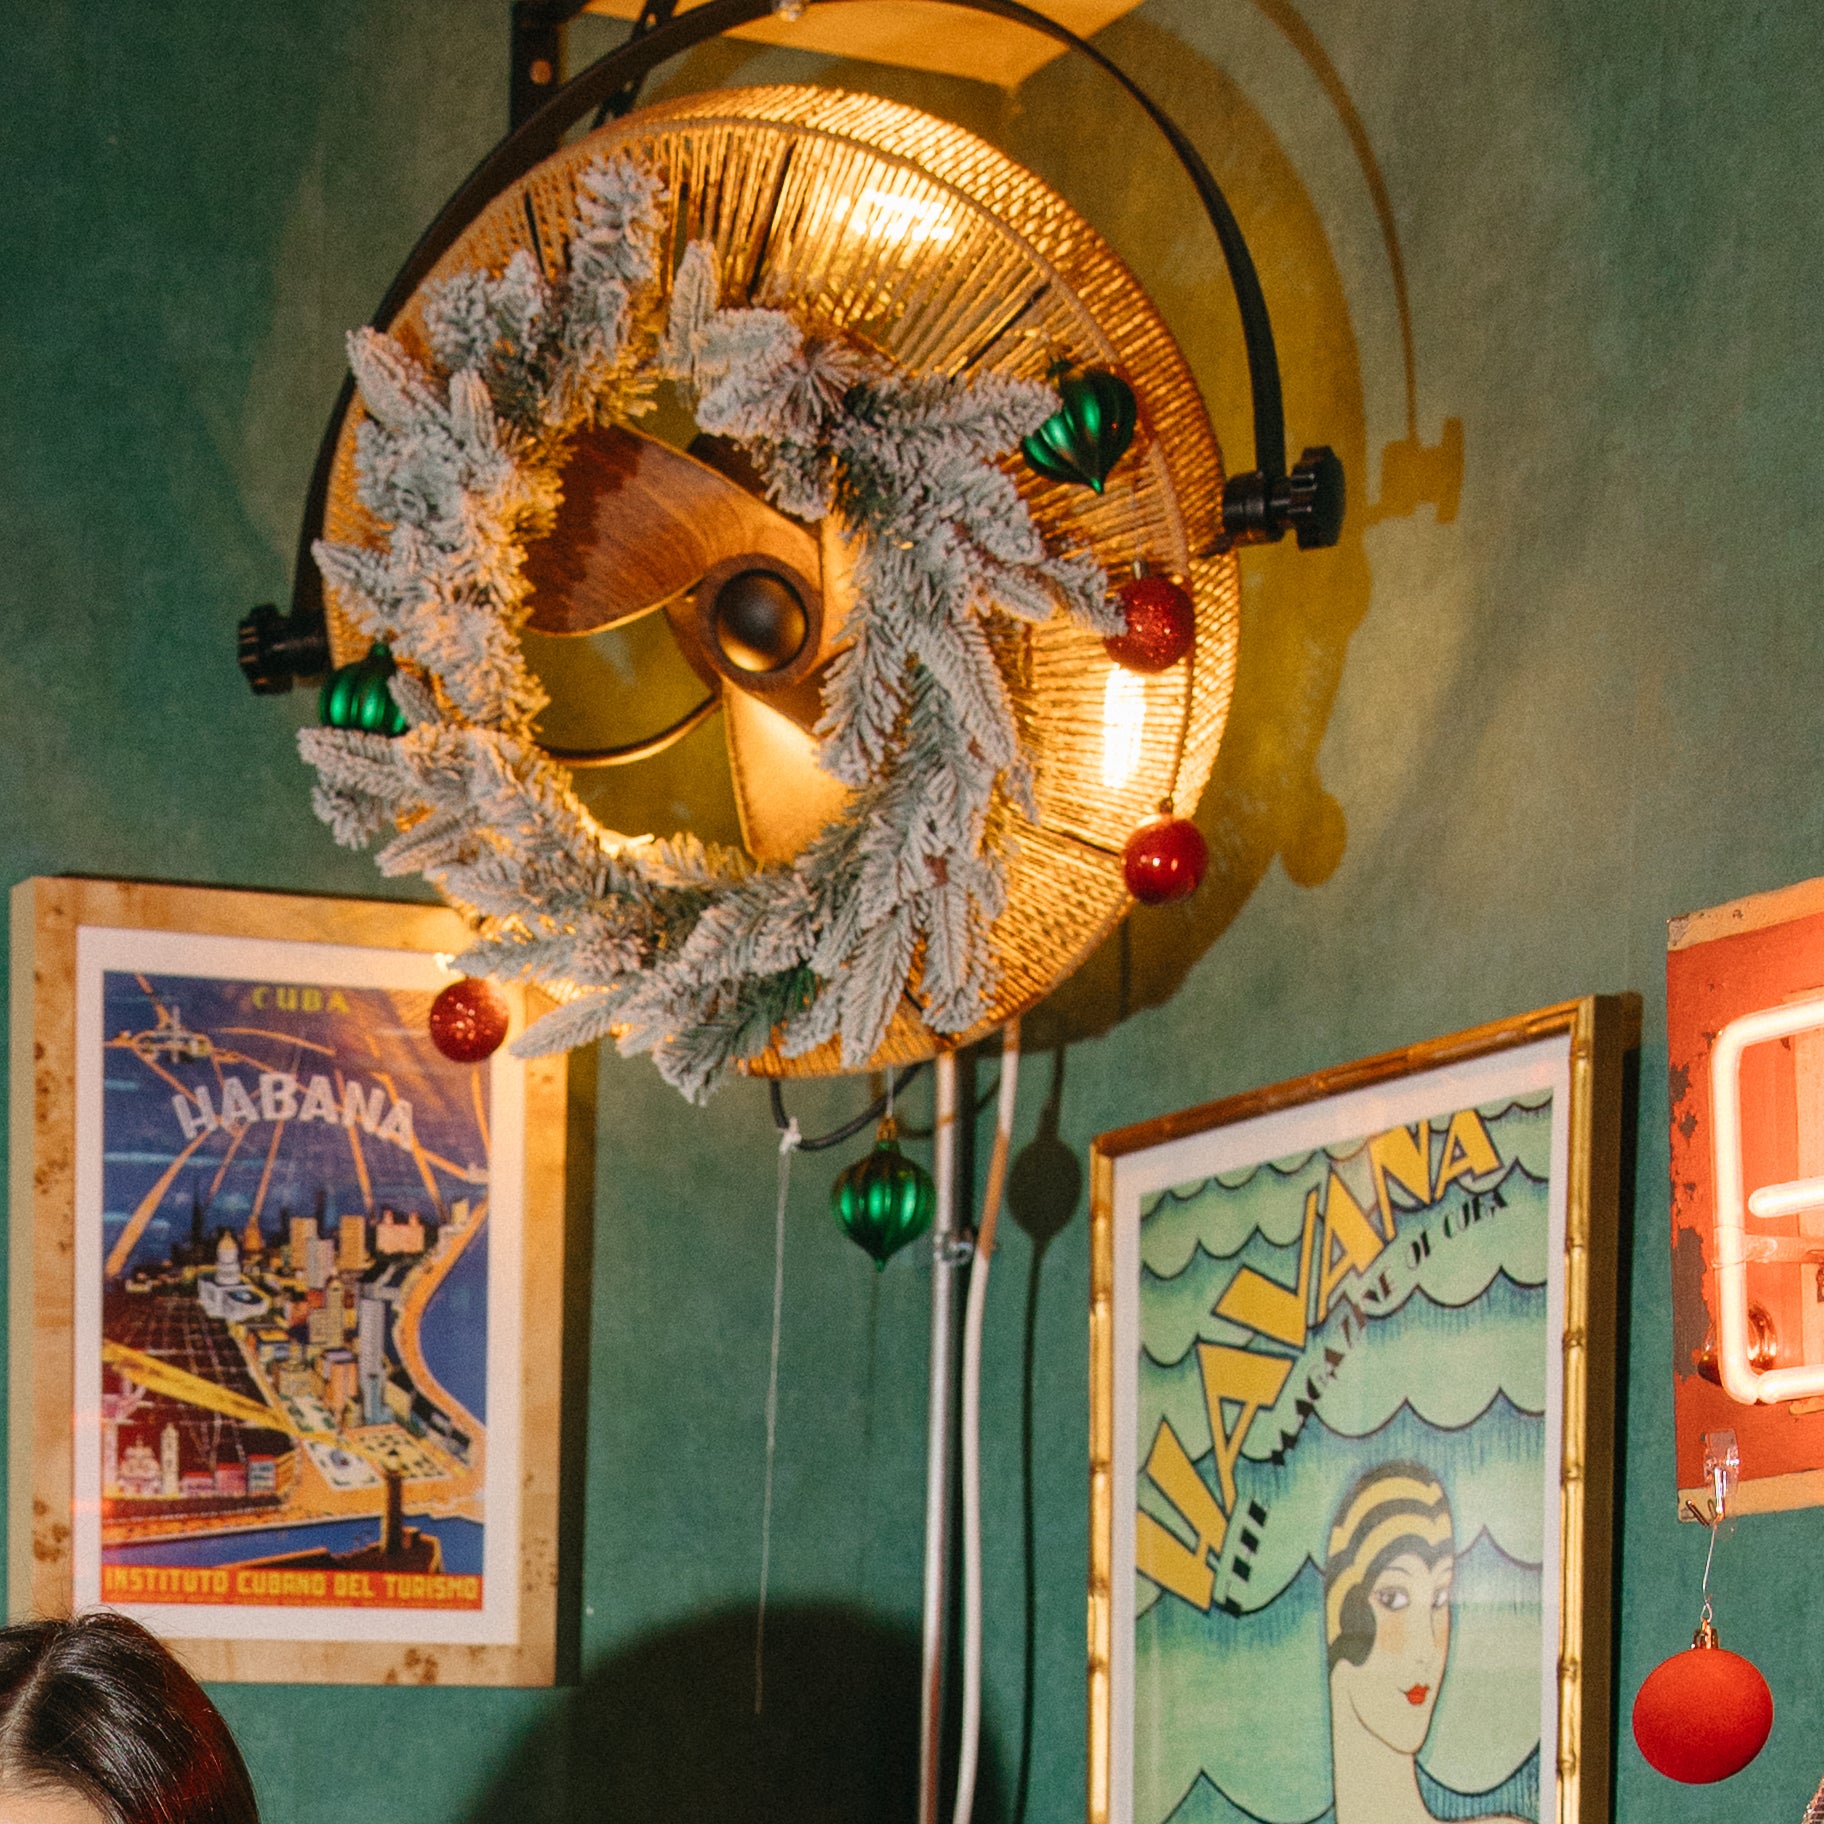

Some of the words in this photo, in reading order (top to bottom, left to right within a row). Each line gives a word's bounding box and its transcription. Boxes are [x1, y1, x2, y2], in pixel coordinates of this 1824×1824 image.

[251, 985, 350, 1014] CUBA
[172, 1073, 413, 1151] HABANA
[1134, 1108, 1502, 1612] HAVANA
[1271, 1265, 1397, 1466] MAGAZINE
[1440, 1186, 1509, 1241] CUBA
[104, 1565, 229, 1594] INSTITUTO
[236, 1569, 327, 1597] CUBANO
[332, 1573, 375, 1598] DEL
[382, 1574, 479, 1601] TURISMO
